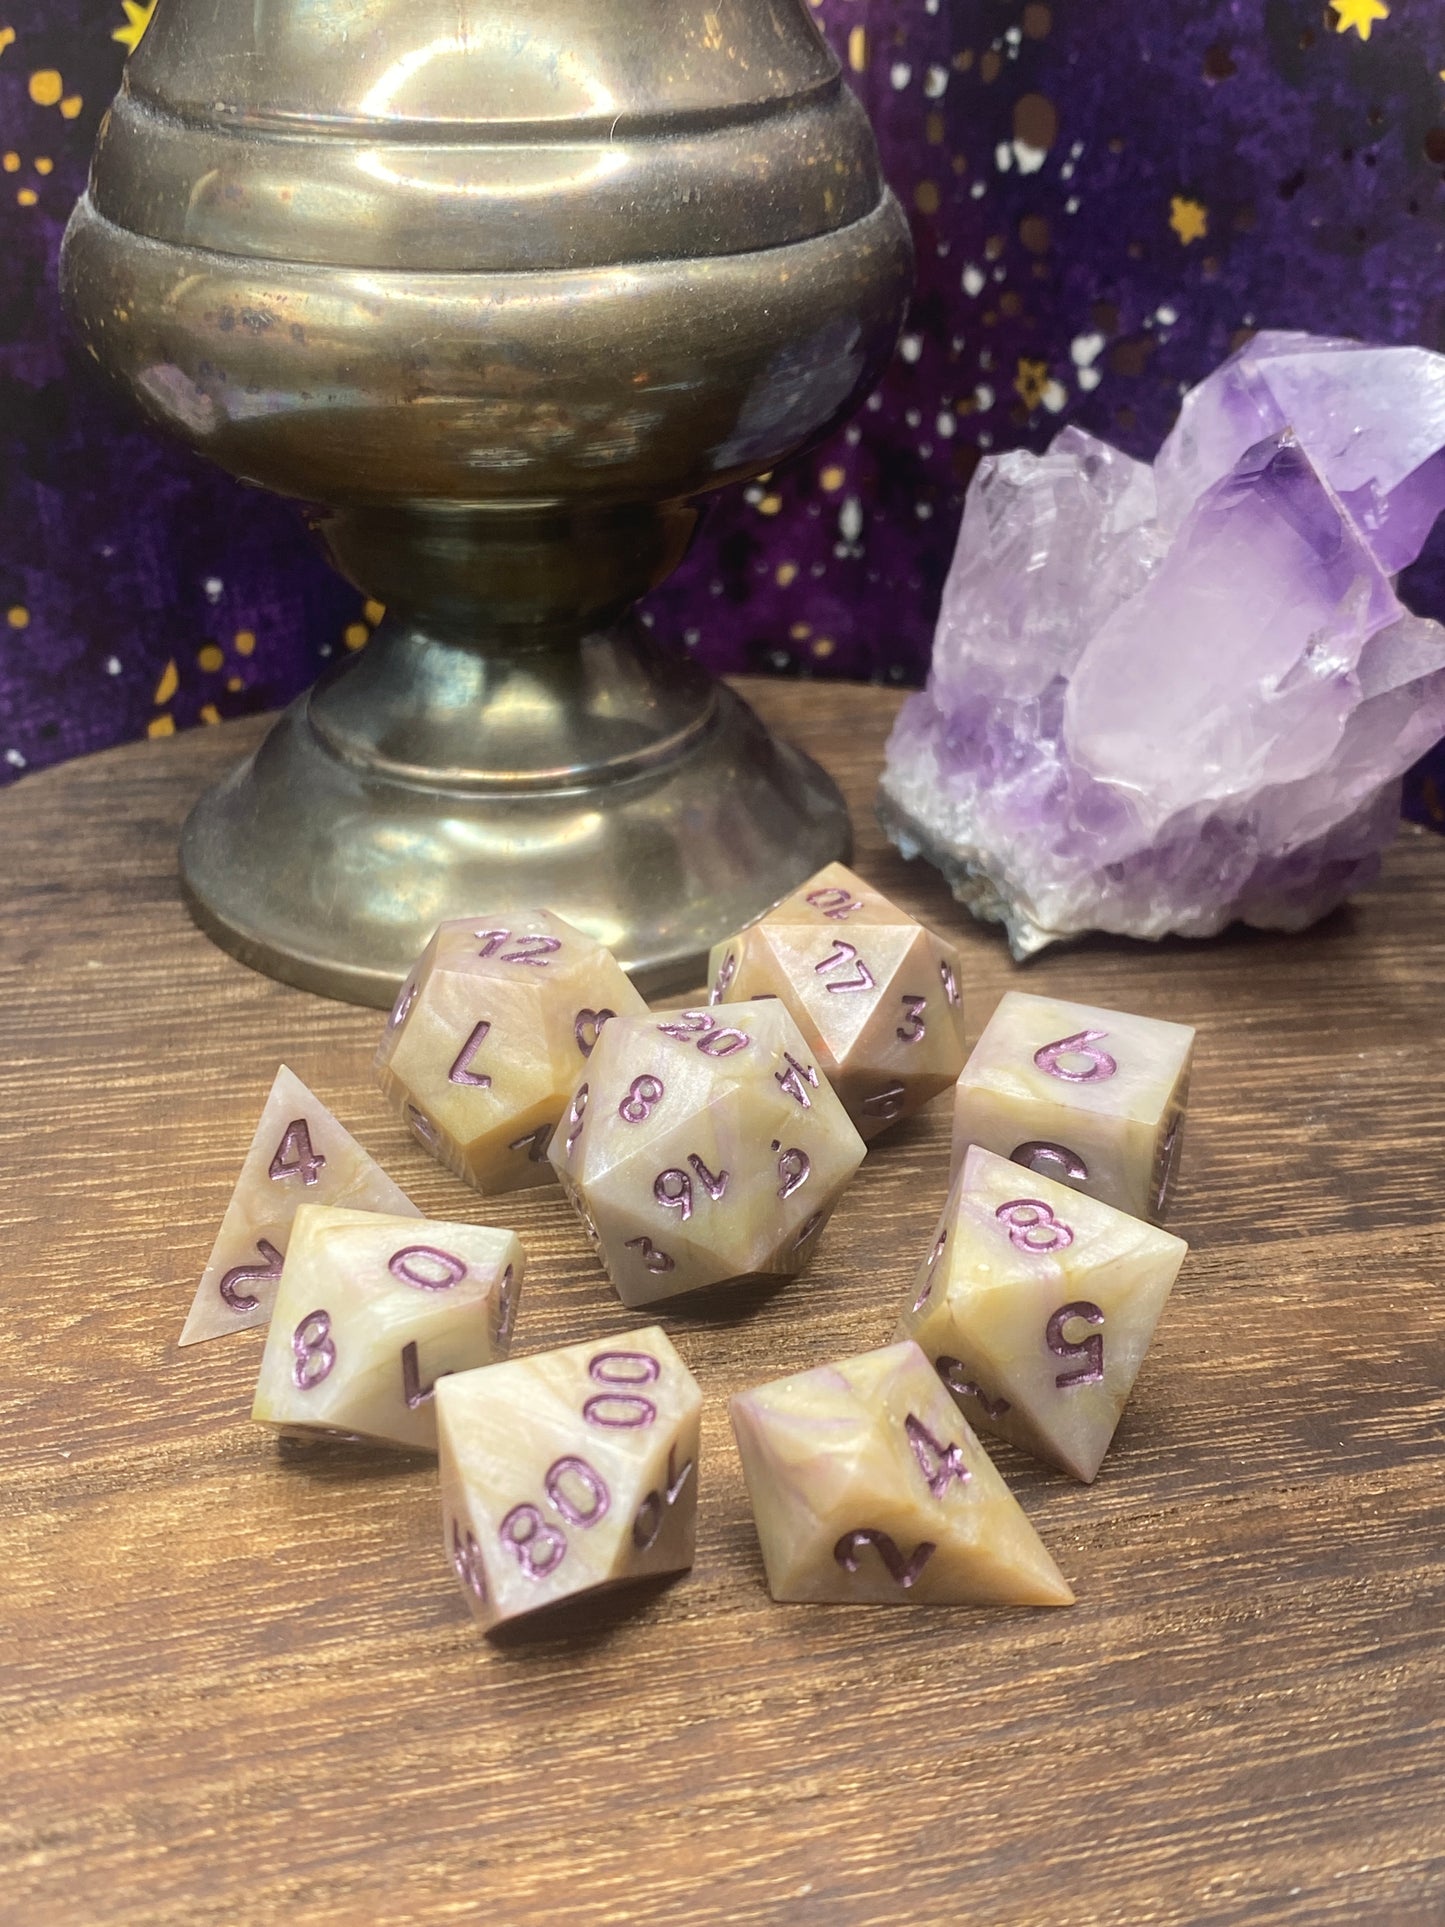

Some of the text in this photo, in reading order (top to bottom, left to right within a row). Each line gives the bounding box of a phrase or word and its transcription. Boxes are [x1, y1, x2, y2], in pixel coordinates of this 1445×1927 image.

[475, 928, 562, 967] 12
[657, 1010, 750, 1057] 20
[896, 995, 927, 1043] 3
[1034, 1030, 1117, 1084] 6
[618, 1074, 665, 1124] 8
[269, 1118, 326, 1186] 4
[996, 1198, 1074, 1254] 8
[220, 1237, 287, 1312] 2
[388, 1244, 468, 1293] 0
[291, 1308, 337, 1391] 8
[1046, 1300, 1106, 1389] 5
[583, 1352, 661, 1429] 00
[904, 1411, 973, 1501] 4
[500, 1455, 612, 1582] 80
[833, 1528, 938, 1589] 2
